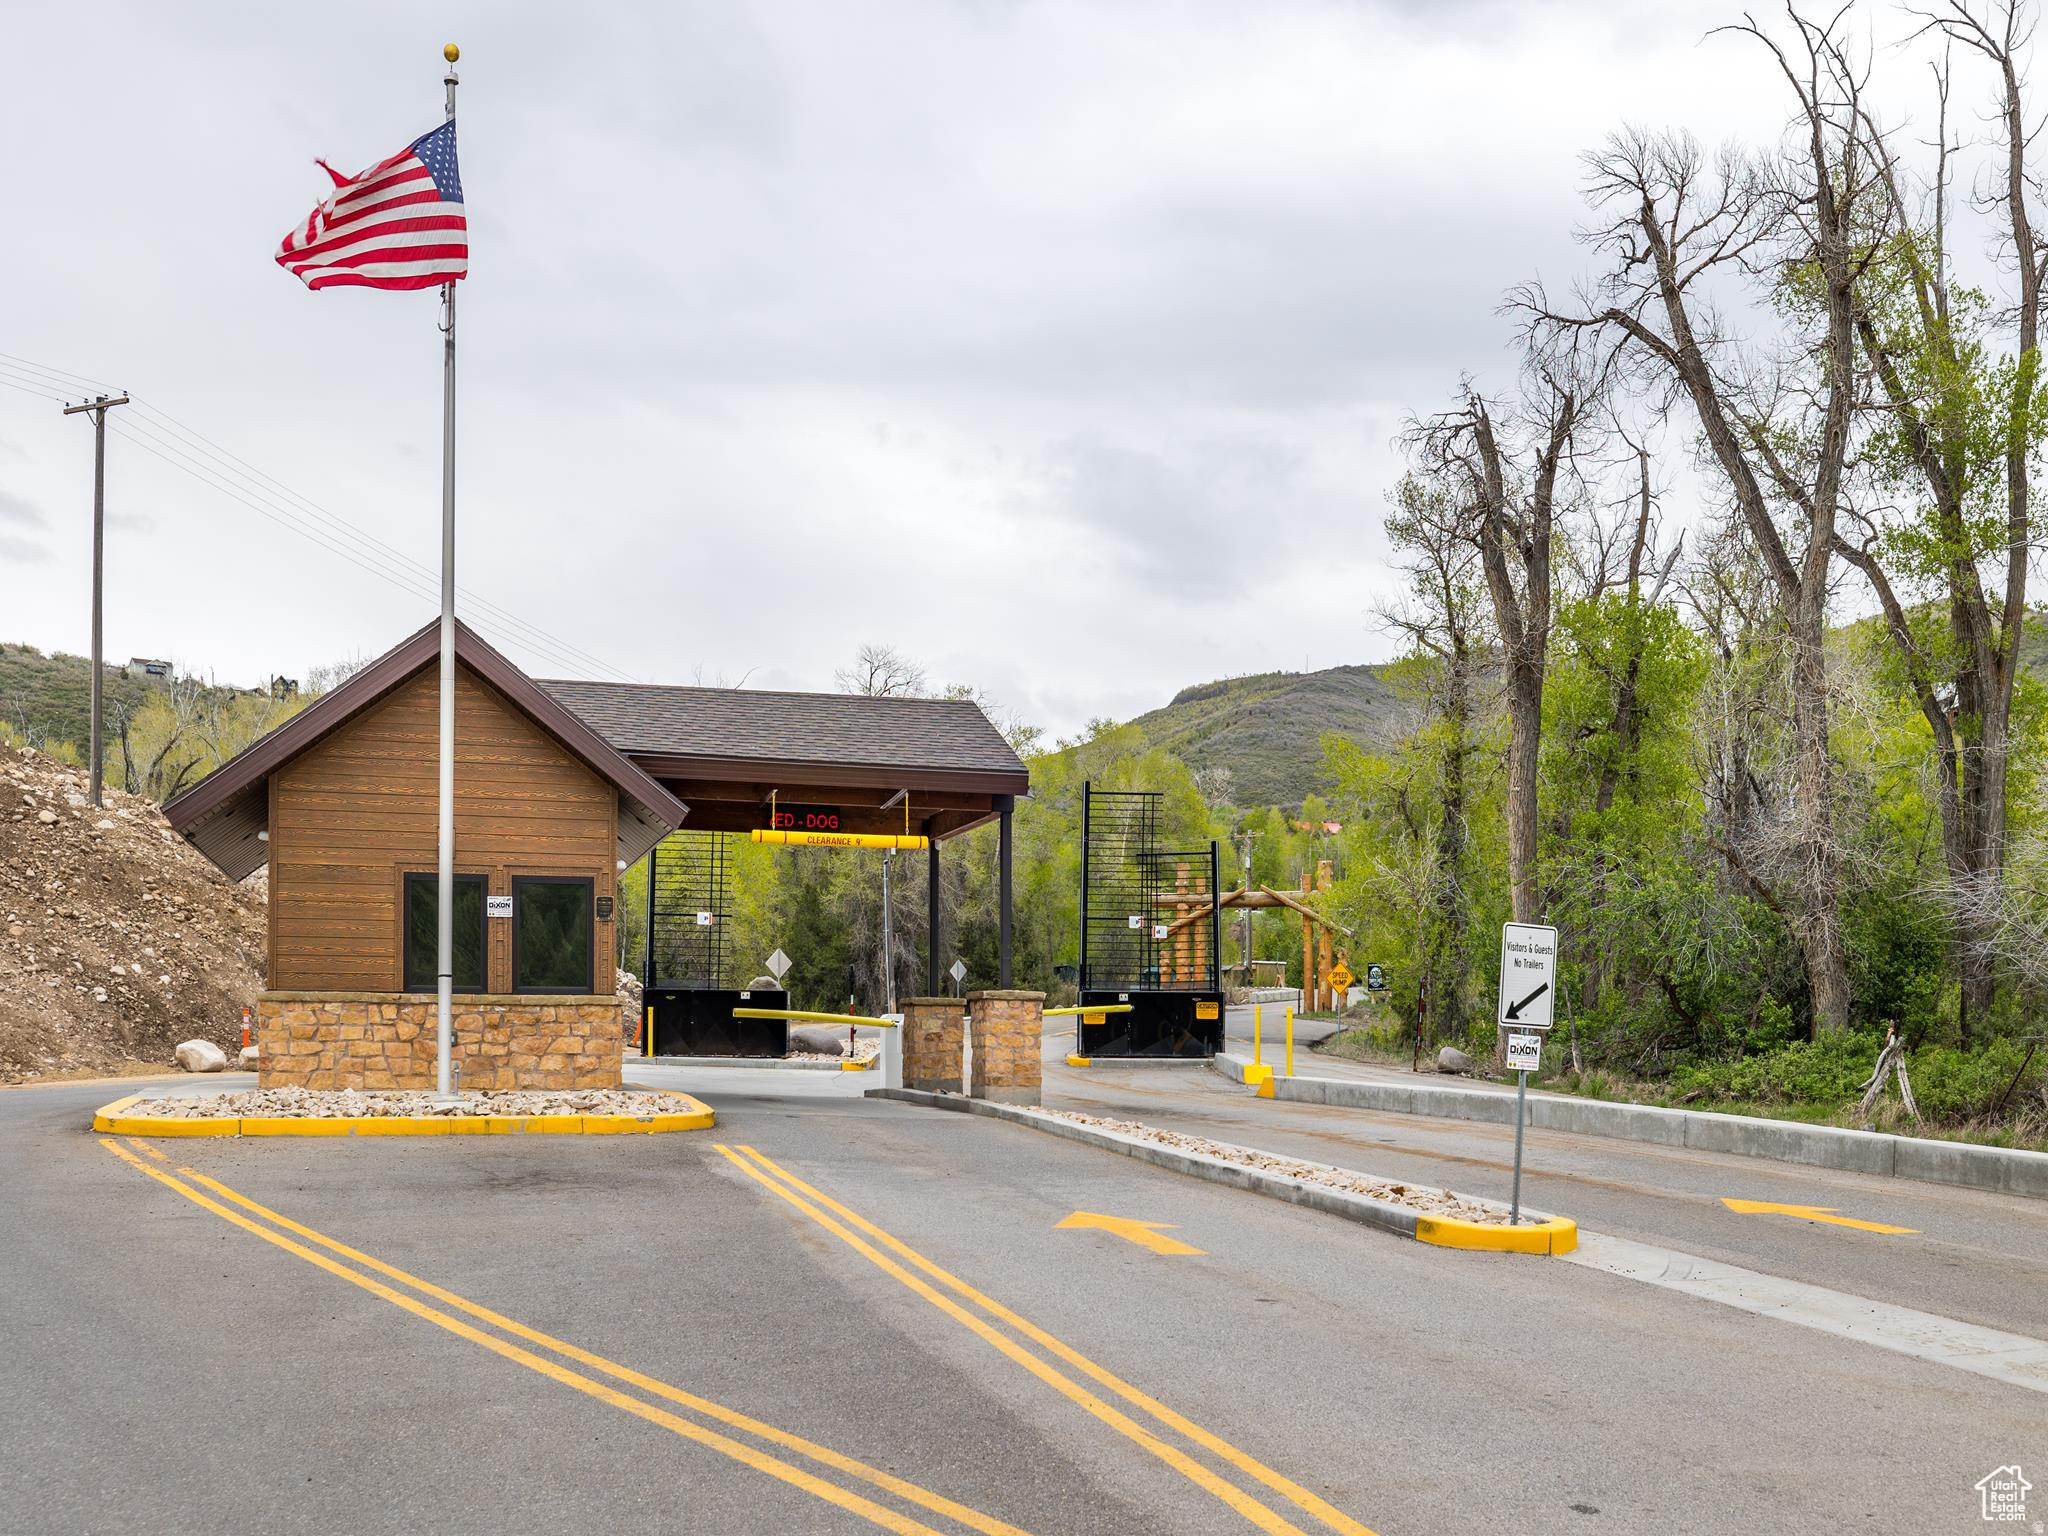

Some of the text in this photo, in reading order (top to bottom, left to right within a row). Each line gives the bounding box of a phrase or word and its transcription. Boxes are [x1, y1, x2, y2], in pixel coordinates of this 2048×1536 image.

[770, 812, 794, 827] ED
[807, 813, 838, 829] DOG
[807, 836, 851, 845] CLEARANCE
[1507, 941, 1553, 955] Visitors & Guests
[1514, 957, 1544, 970] No Trailers
[1332, 971, 1348, 979] SPEED
